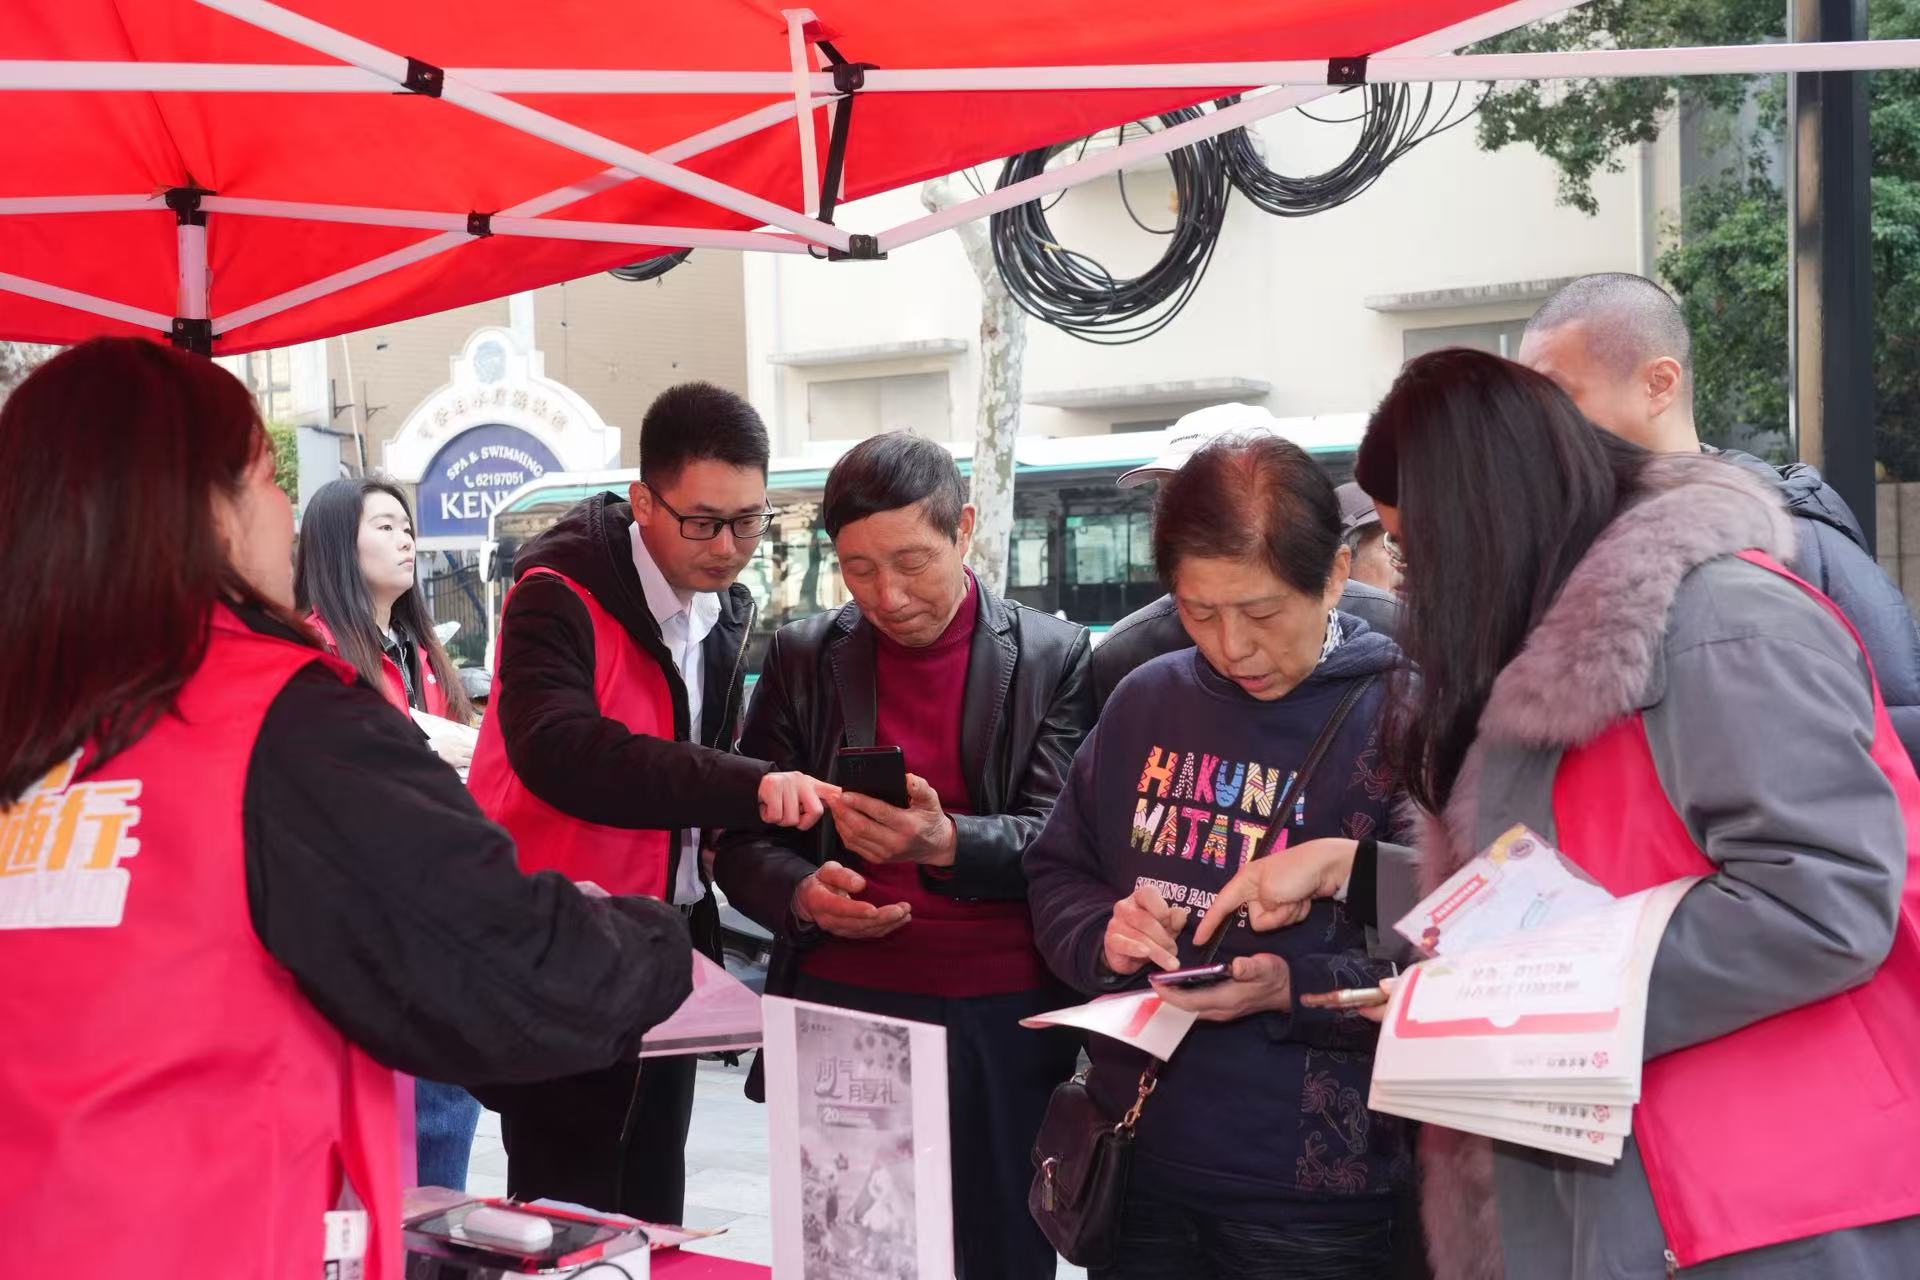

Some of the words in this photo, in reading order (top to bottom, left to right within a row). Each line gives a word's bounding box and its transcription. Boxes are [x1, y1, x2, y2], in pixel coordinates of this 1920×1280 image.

[446, 457, 470, 481] SPA
[480, 445, 545, 478] SWIMMING
[440, 490, 510, 520] KEN
